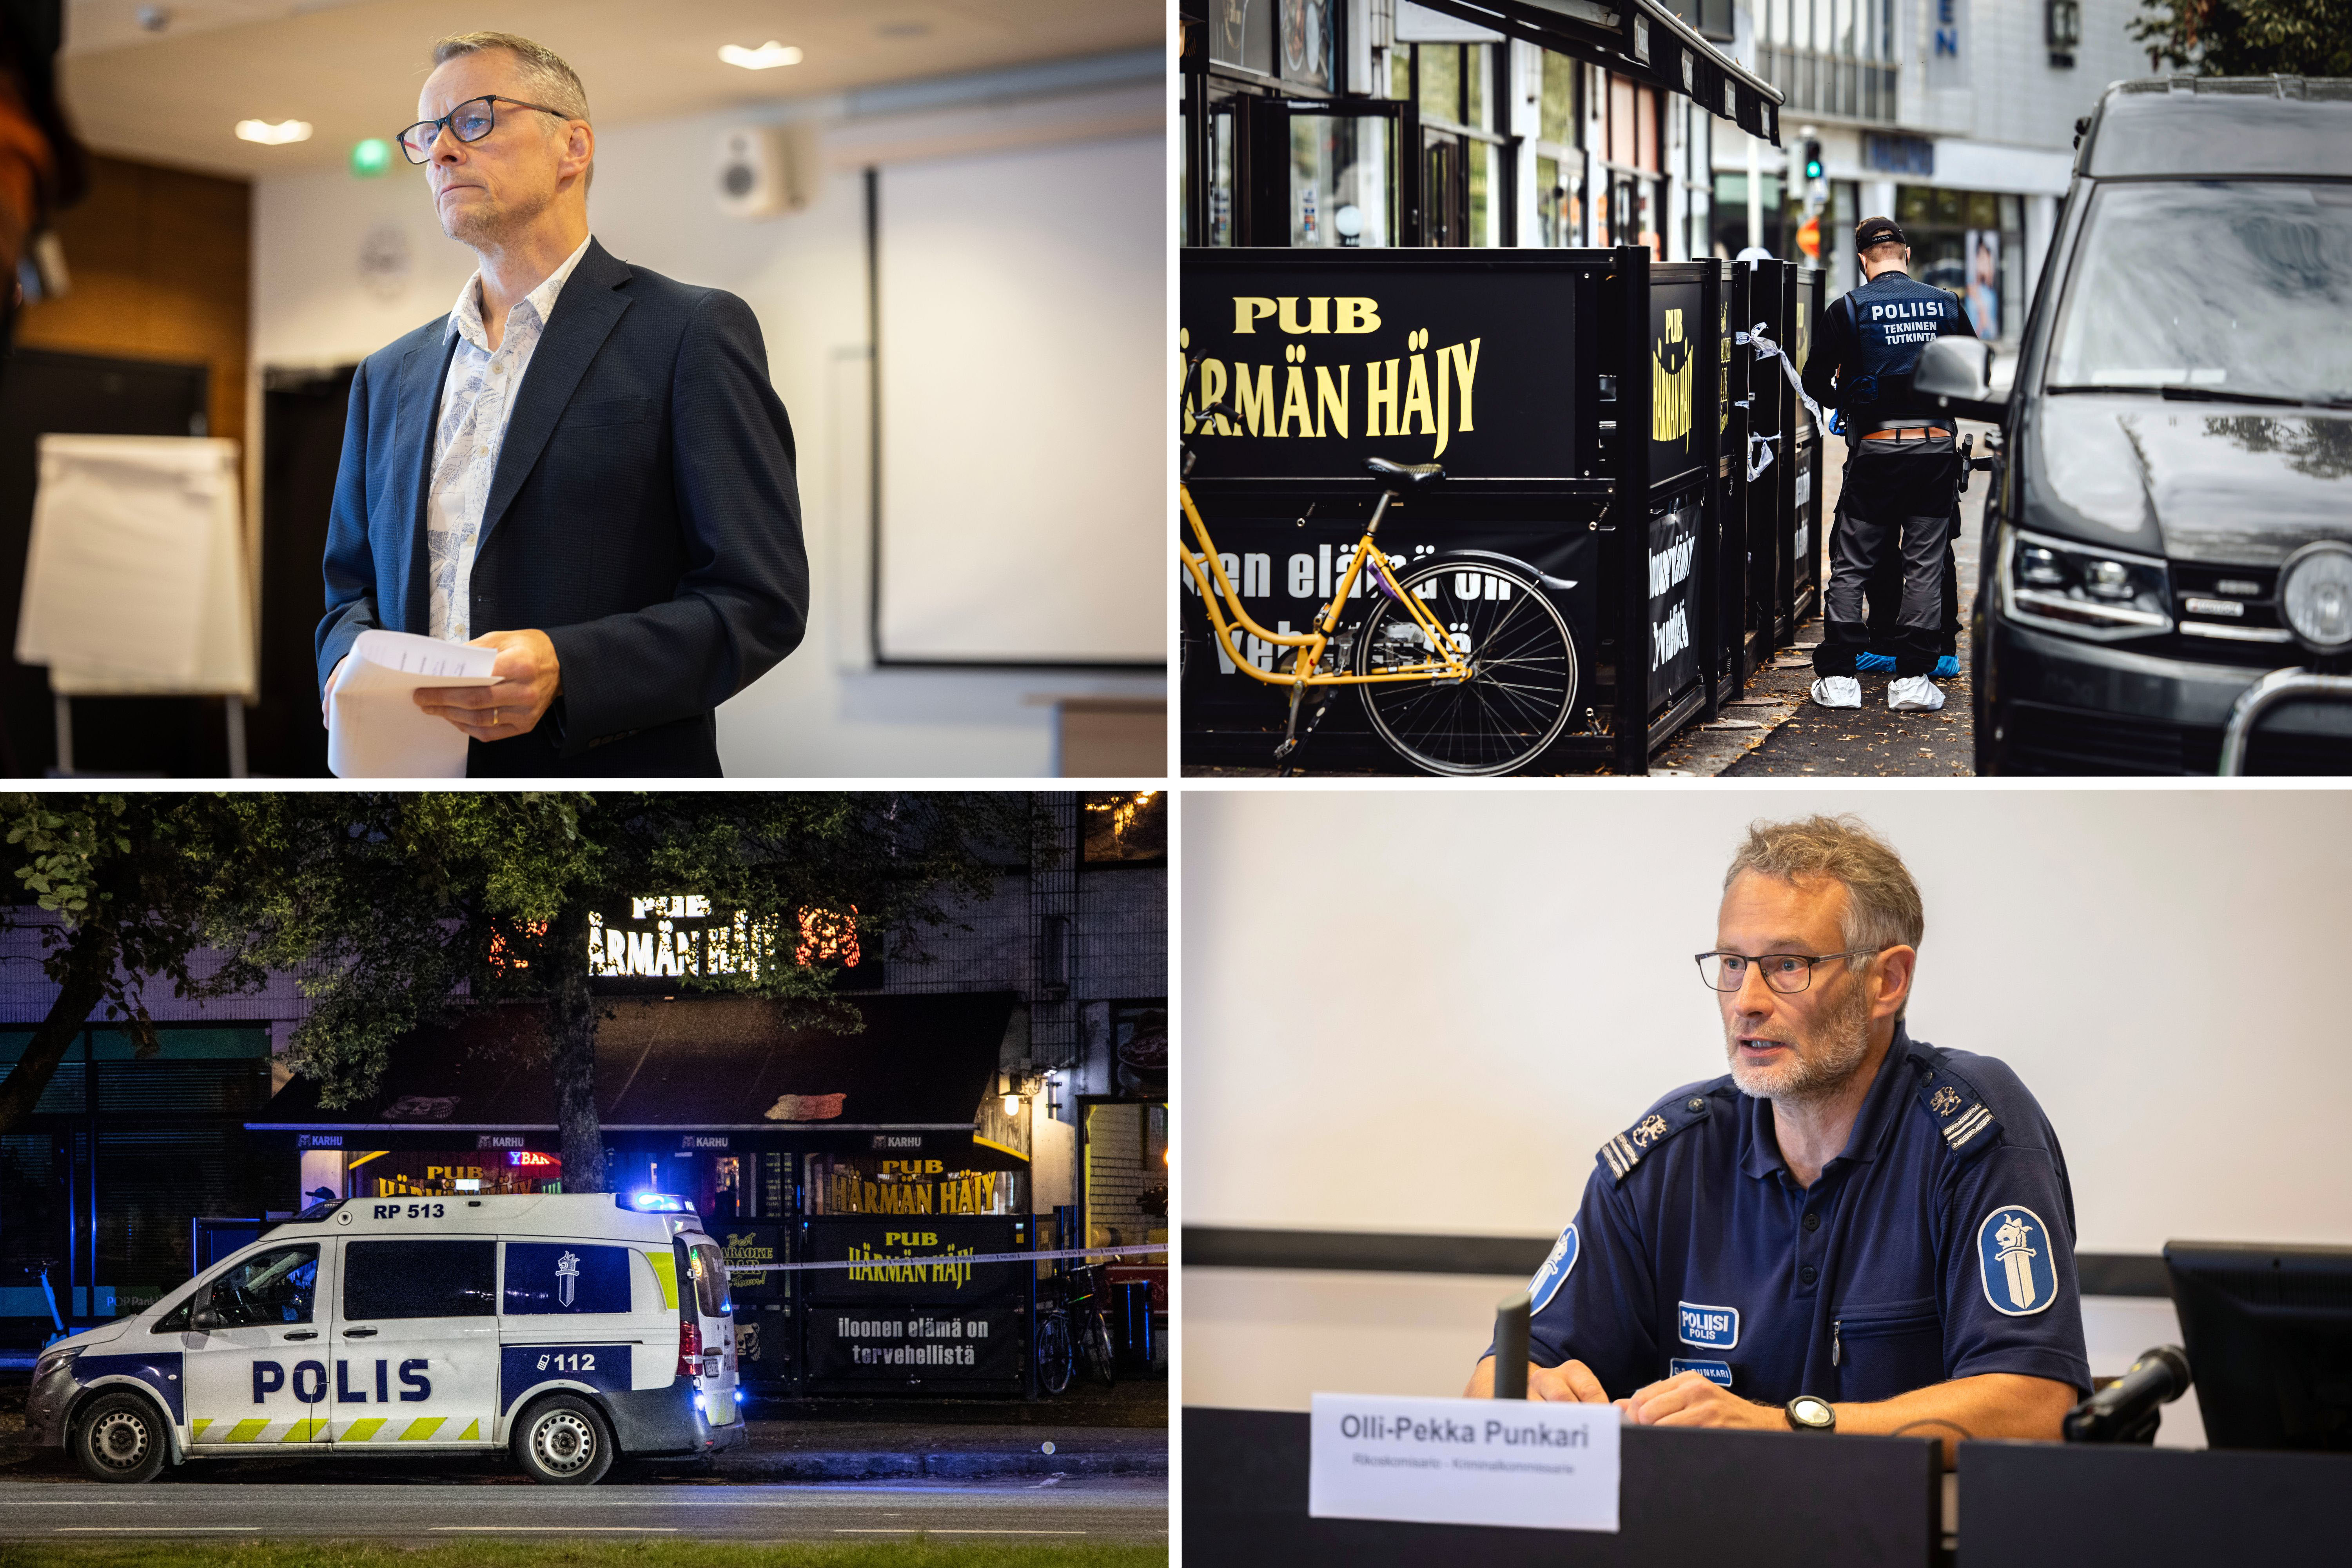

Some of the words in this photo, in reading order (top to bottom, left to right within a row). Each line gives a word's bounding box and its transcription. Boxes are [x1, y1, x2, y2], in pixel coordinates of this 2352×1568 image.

[1233, 297, 1381, 334] PUB
[1872, 302, 1944, 321] POLIISI
[1666, 309, 1682, 344] PUB
[1883, 321, 1937, 334] TEKNINEN
[1885, 333, 1937, 345] TUTKINTA
[1366, 327, 1481, 459] HÄJY
[632, 895, 712, 919] PUB
[588, 911, 700, 977] ÄRMÄN
[312, 1136, 343, 1146] KARHU
[492, 1137, 524, 1147] KARHU
[696, 1137, 728, 1147] KARHU
[887, 1136, 921, 1147] KARHU
[427, 1166, 485, 1179] PUB
[882, 1160, 943, 1174] PUB
[830, 1169, 933, 1215] HÄRMÄN
[940, 1169, 997, 1215] HÄJY
[374, 1204, 401, 1219] RP
[407, 1203, 445, 1218] 513
[726, 1232, 756, 1247] Best
[885, 1232, 938, 1246] PUB
[721, 1247, 773, 1259] ARAOKE
[849, 1243, 927, 1282] HÄRMÄN
[932, 1243, 974, 1290] HÄJY
[107, 1296, 131, 1307] POP
[131, 1296, 164, 1306] Pank
[838, 1318, 902, 1337] iloonen
[908, 1318, 962, 1337] elämä
[967, 1321, 988, 1338] on
[1682, 1310, 1729, 1332] POLIISI
[1689, 1328, 1716, 1340] POLIS
[554, 1354, 595, 1370] 112
[852, 1345, 975, 1365] tervehellistä
[253, 1359, 433, 1403] POLIS
[1691, 1368, 1729, 1378] UNKARI
[1341, 1414, 1476, 1443] Olli-Pekka
[1485, 1420, 1589, 1448] Punkari
